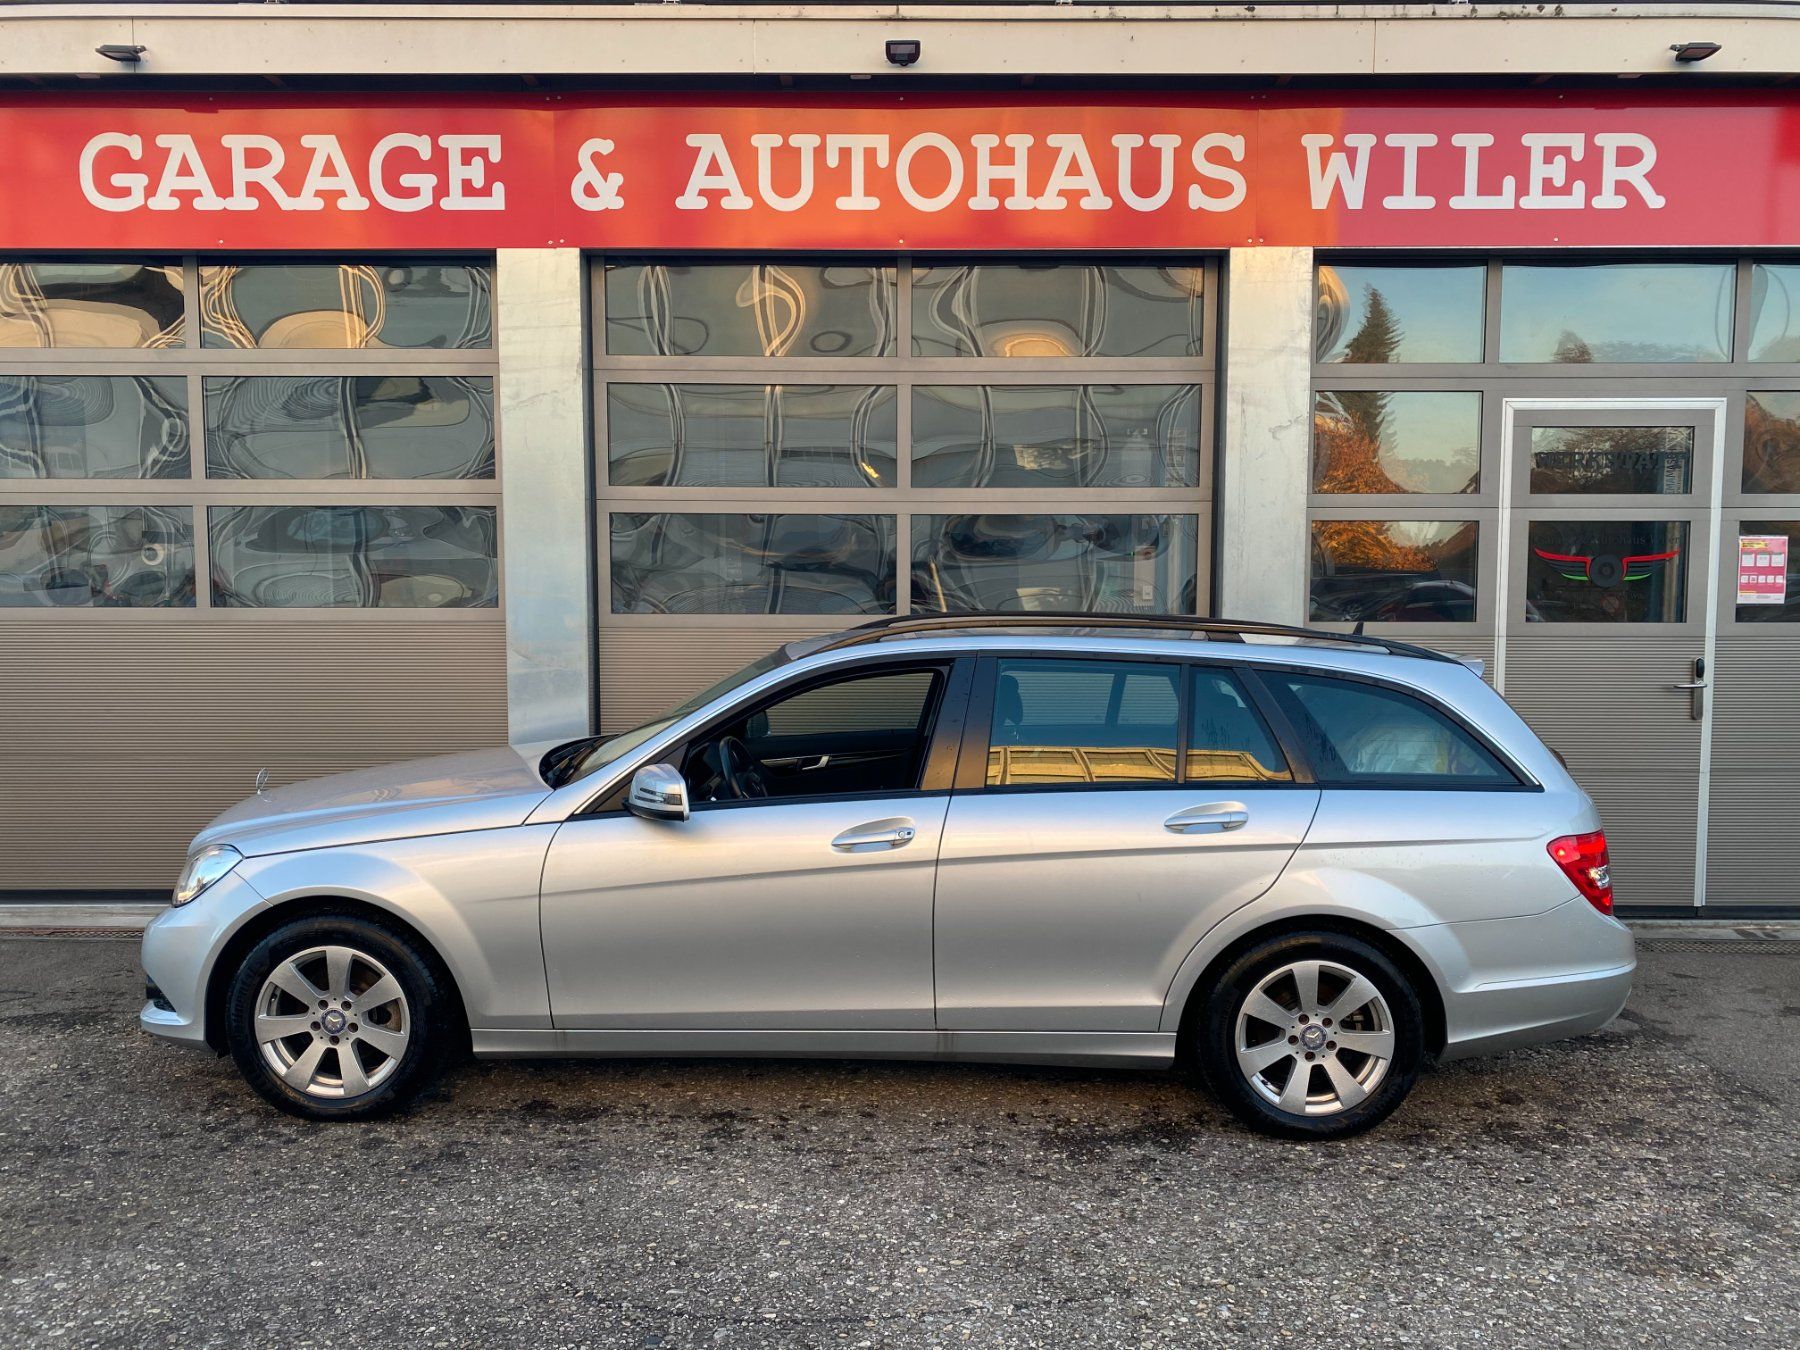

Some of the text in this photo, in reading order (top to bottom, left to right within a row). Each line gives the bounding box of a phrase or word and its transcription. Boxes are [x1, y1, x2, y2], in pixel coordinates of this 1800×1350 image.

[79, 132, 1666, 213] GARAGE & AUTOHAUS WILER
